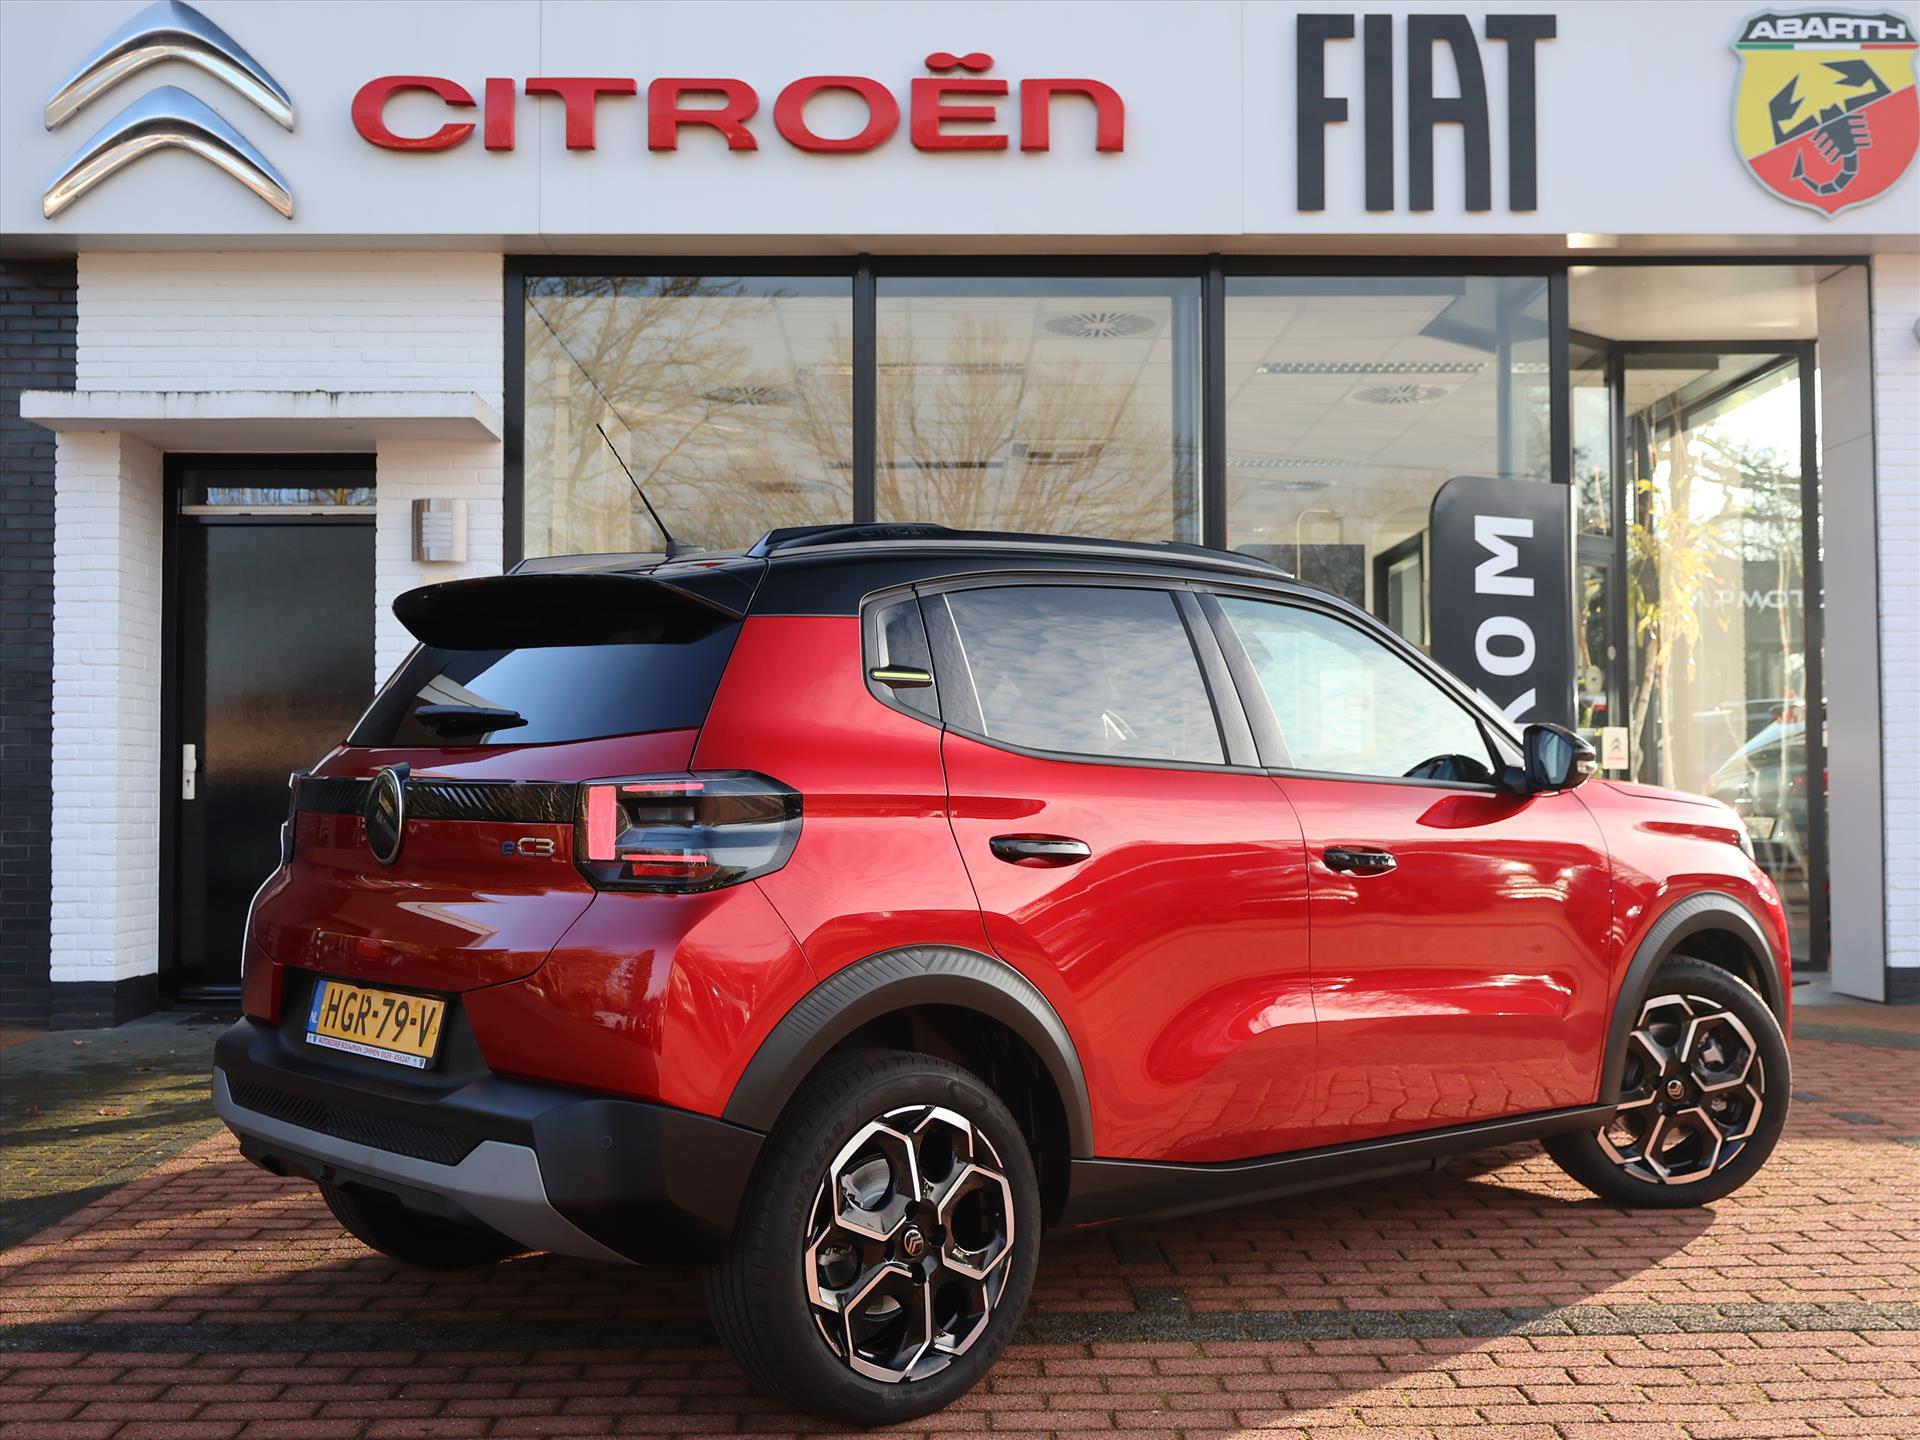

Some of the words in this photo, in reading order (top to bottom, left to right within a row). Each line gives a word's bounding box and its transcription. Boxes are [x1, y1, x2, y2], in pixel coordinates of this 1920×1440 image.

[1748, 16, 1906, 40] ABARTH
[1297, 13, 1557, 211] FIAT
[323, 988, 437, 1048] HGR-79-V
